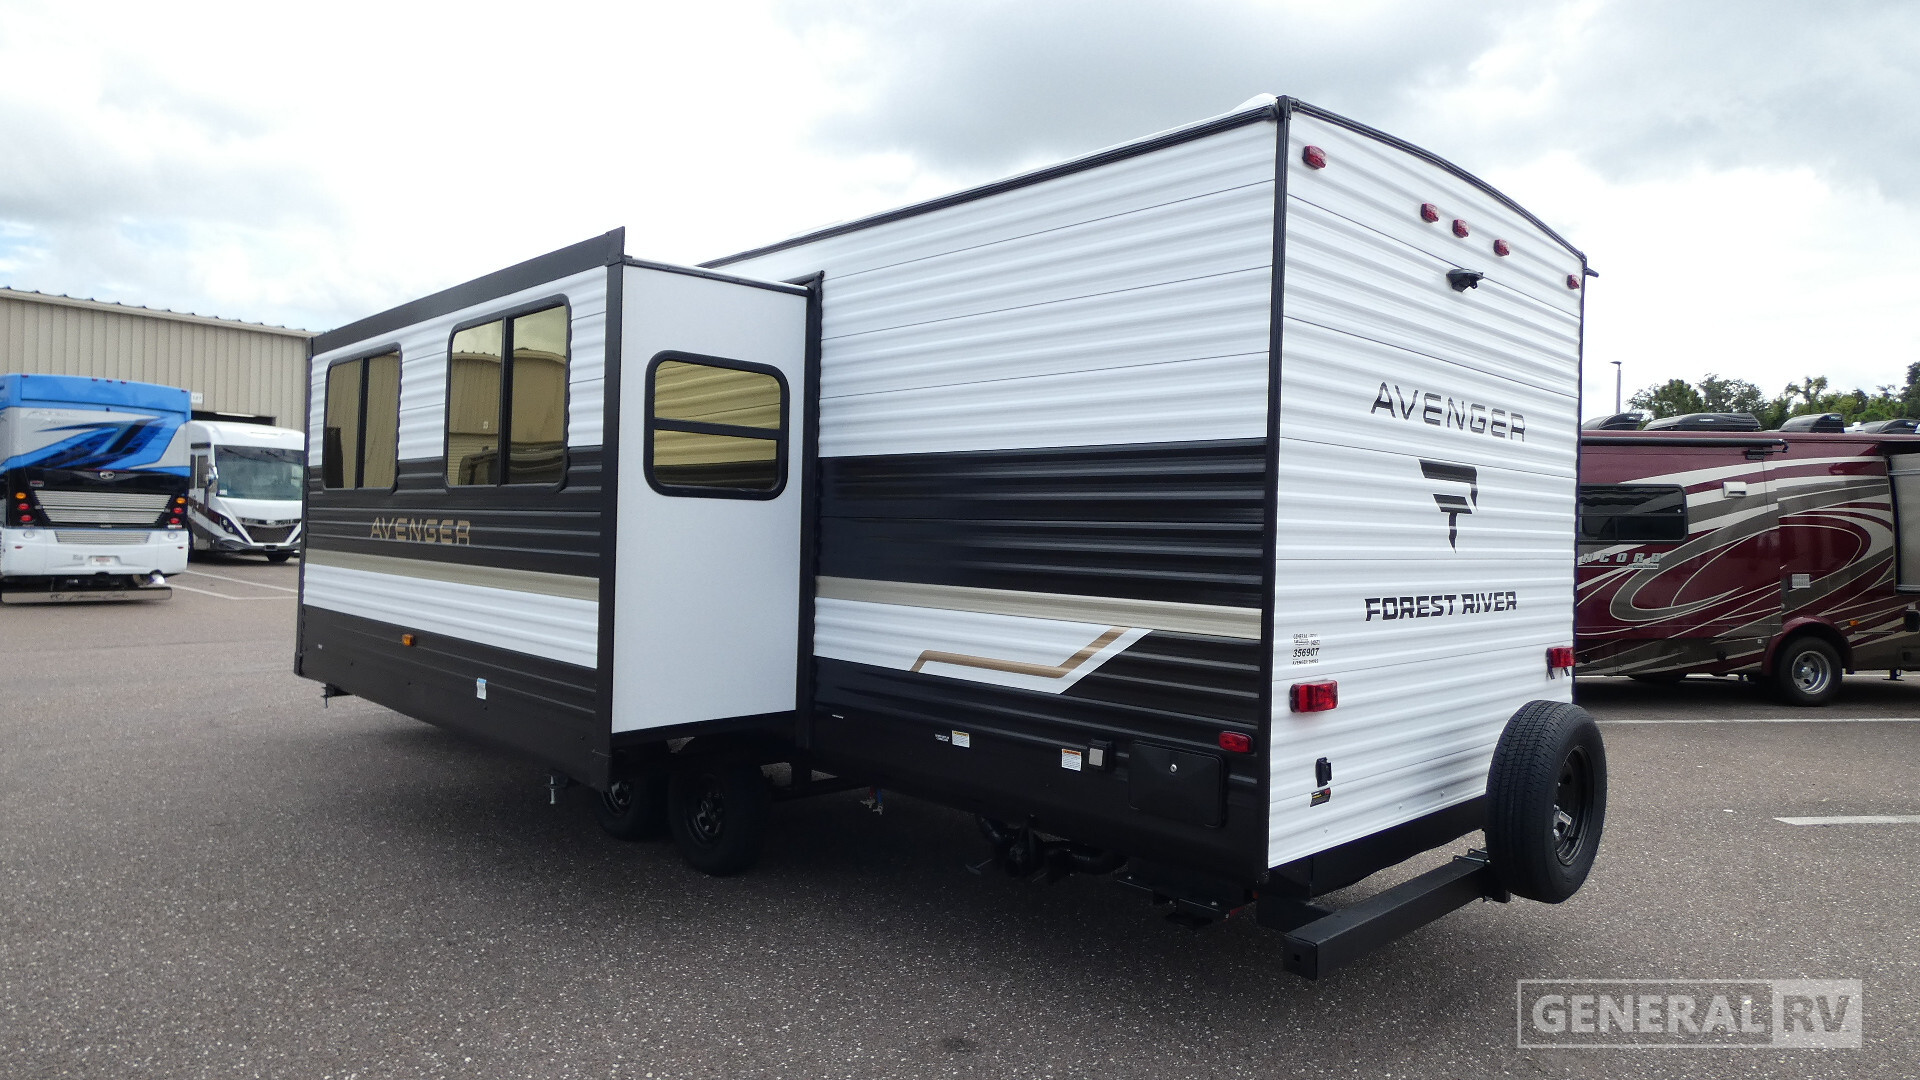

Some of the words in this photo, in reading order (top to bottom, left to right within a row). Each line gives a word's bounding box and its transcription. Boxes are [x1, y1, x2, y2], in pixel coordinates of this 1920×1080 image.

[1370, 381, 1526, 442] AVENGER
[370, 517, 471, 546] AVENGER
[1364, 594, 1457, 622] FOREST
[1461, 591, 1518, 615] RIVER
[1292, 648, 1320, 658] 356907
